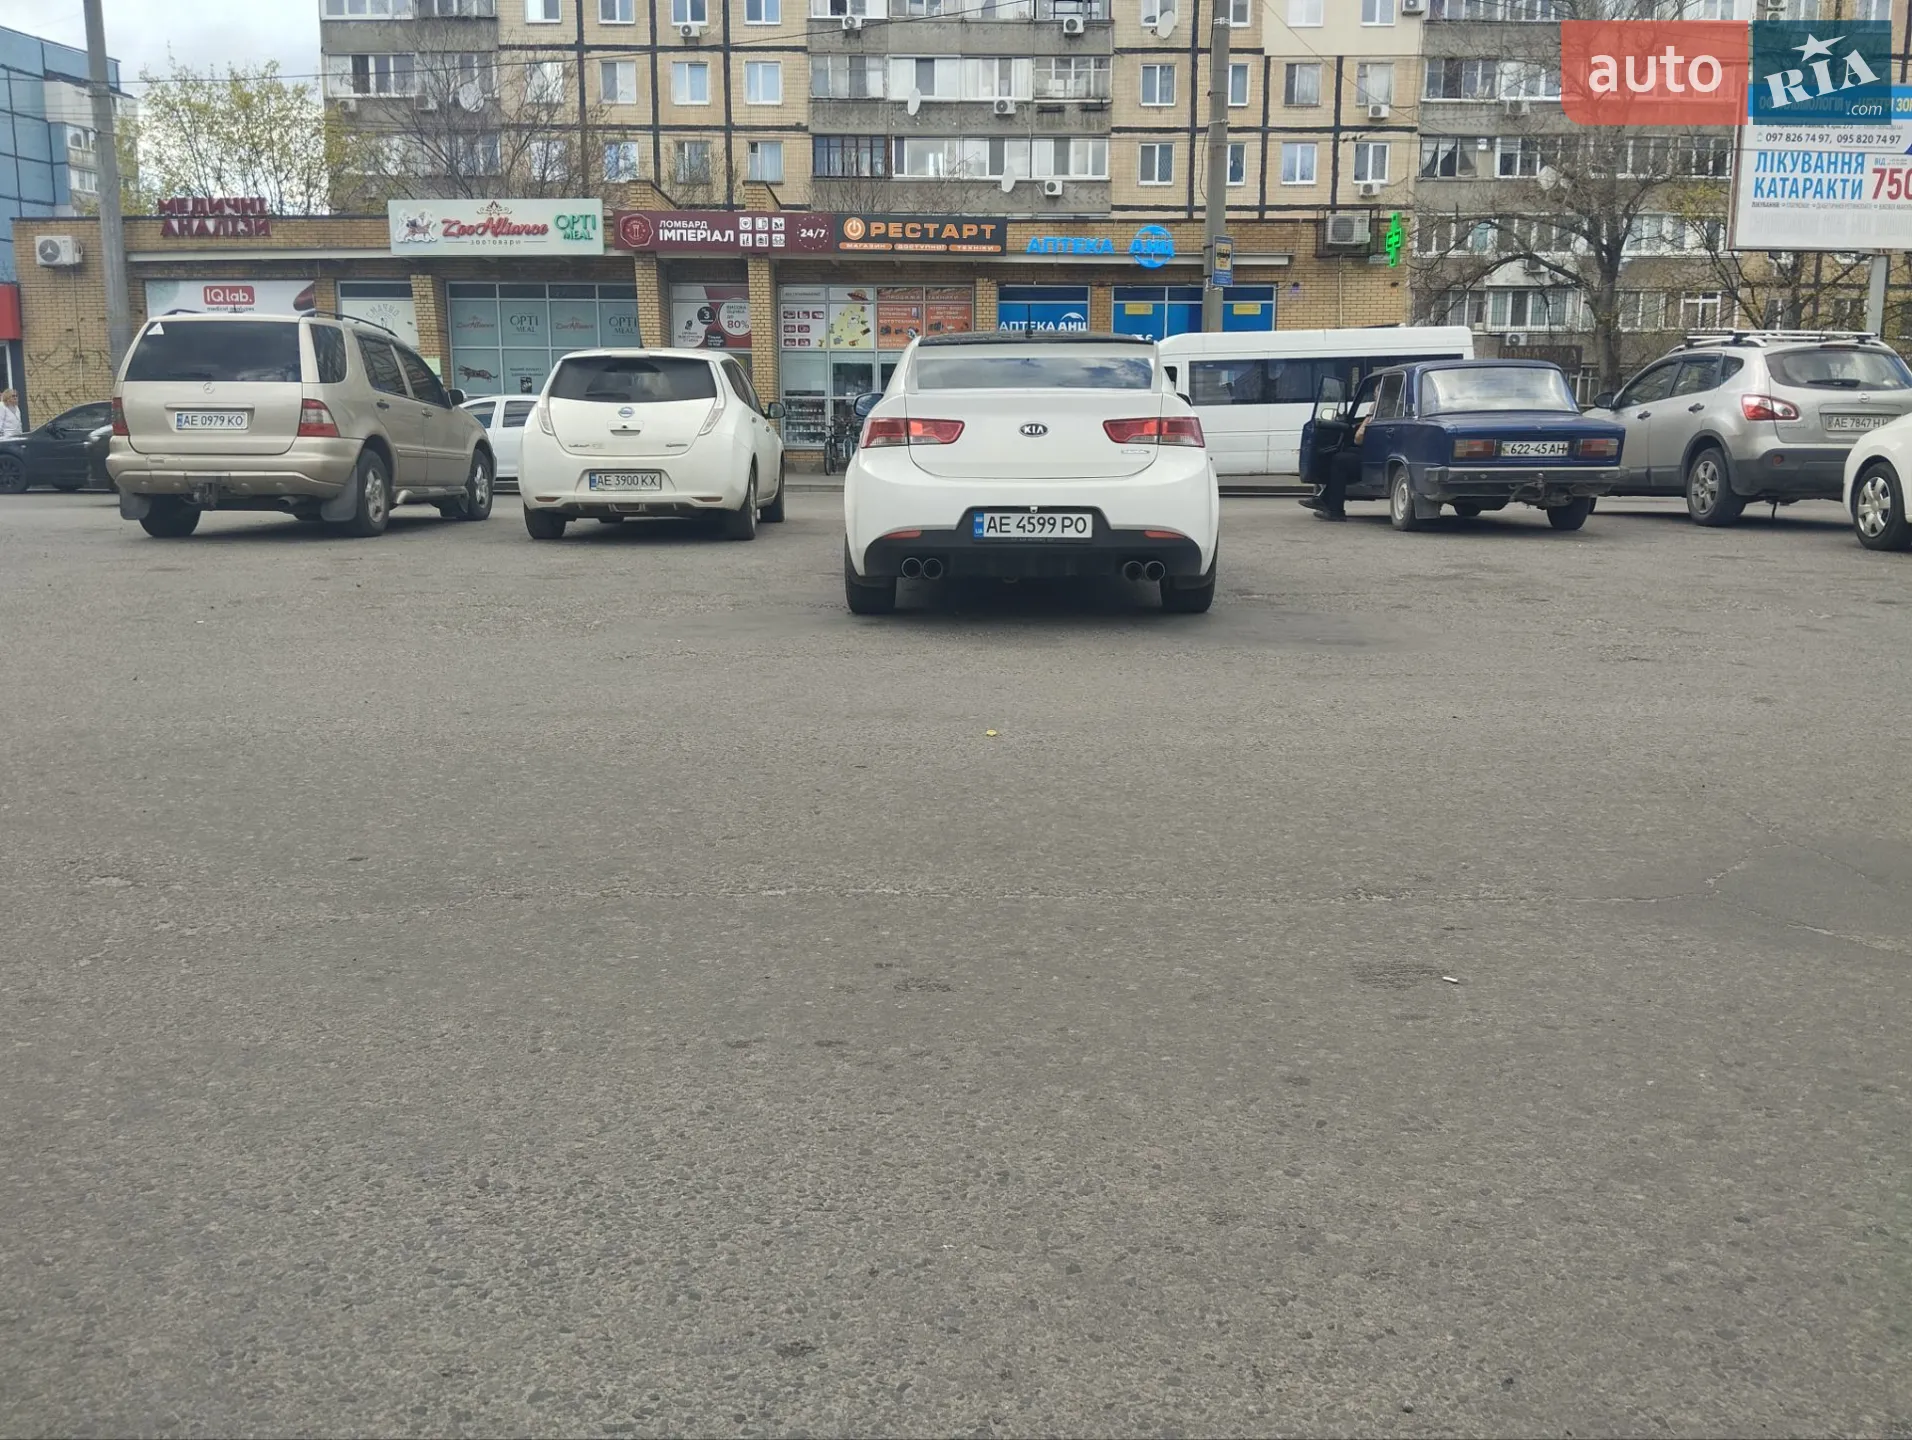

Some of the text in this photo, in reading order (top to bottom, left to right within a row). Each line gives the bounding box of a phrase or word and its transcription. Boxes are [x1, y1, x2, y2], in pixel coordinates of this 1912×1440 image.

[1765, 132, 1901, 144] 097 826 74 97, 095 820 74 97
[1754, 151, 1866, 174] ЛІКУВАННЯ
[1753, 177, 1863, 200] КАТАРАКТИ
[158, 196, 269, 215] МЕДИЧНІ
[161, 218, 272, 237] АНАЛІЗИ
[554, 214, 597, 231] OPTI
[659, 219, 708, 229] ЛОМБАРД
[562, 230, 594, 241] MEAL
[658, 229, 734, 243] ІМПЕРІАЛ
[800, 228, 826, 238] 24/7
[869, 222, 997, 239] РЕСТАРТ
[1026, 236, 1115, 255] АПТЕКА
[206, 288, 224, 302] IQ
[509, 314, 539, 326] OPTI
[608, 315, 638, 327] OPTI
[727, 320, 750, 329] 80%
[1000, 321, 1087, 331] АПТЕКА АНЦ
[183, 415, 198, 426] AE
[200, 415, 225, 426] 0979
[227, 415, 243, 426] KO
[1833, 417, 1849, 428] AE
[1850, 417, 1871, 428] 7847
[1024, 424, 1044, 434] KIA
[1510, 443, 1547, 455] 622-45
[597, 475, 656, 486] AE 3900 KX
[986, 516, 1087, 534] AE 4599 PO
